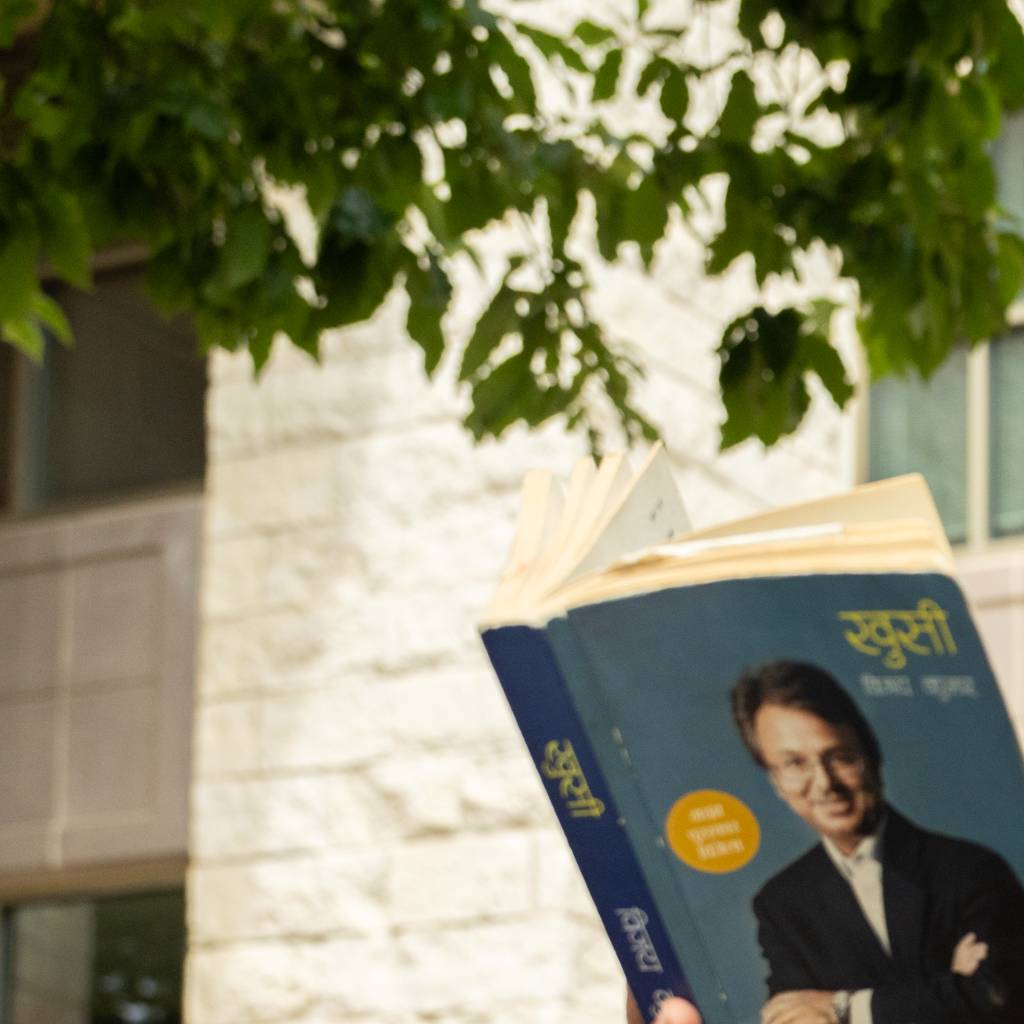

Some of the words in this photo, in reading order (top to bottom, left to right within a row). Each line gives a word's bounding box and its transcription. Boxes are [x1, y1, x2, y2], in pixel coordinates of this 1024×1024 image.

[838, 598, 957, 670] खुसी
[541, 737, 605, 817] खुसी
[614, 906, 664, 973] विजय
